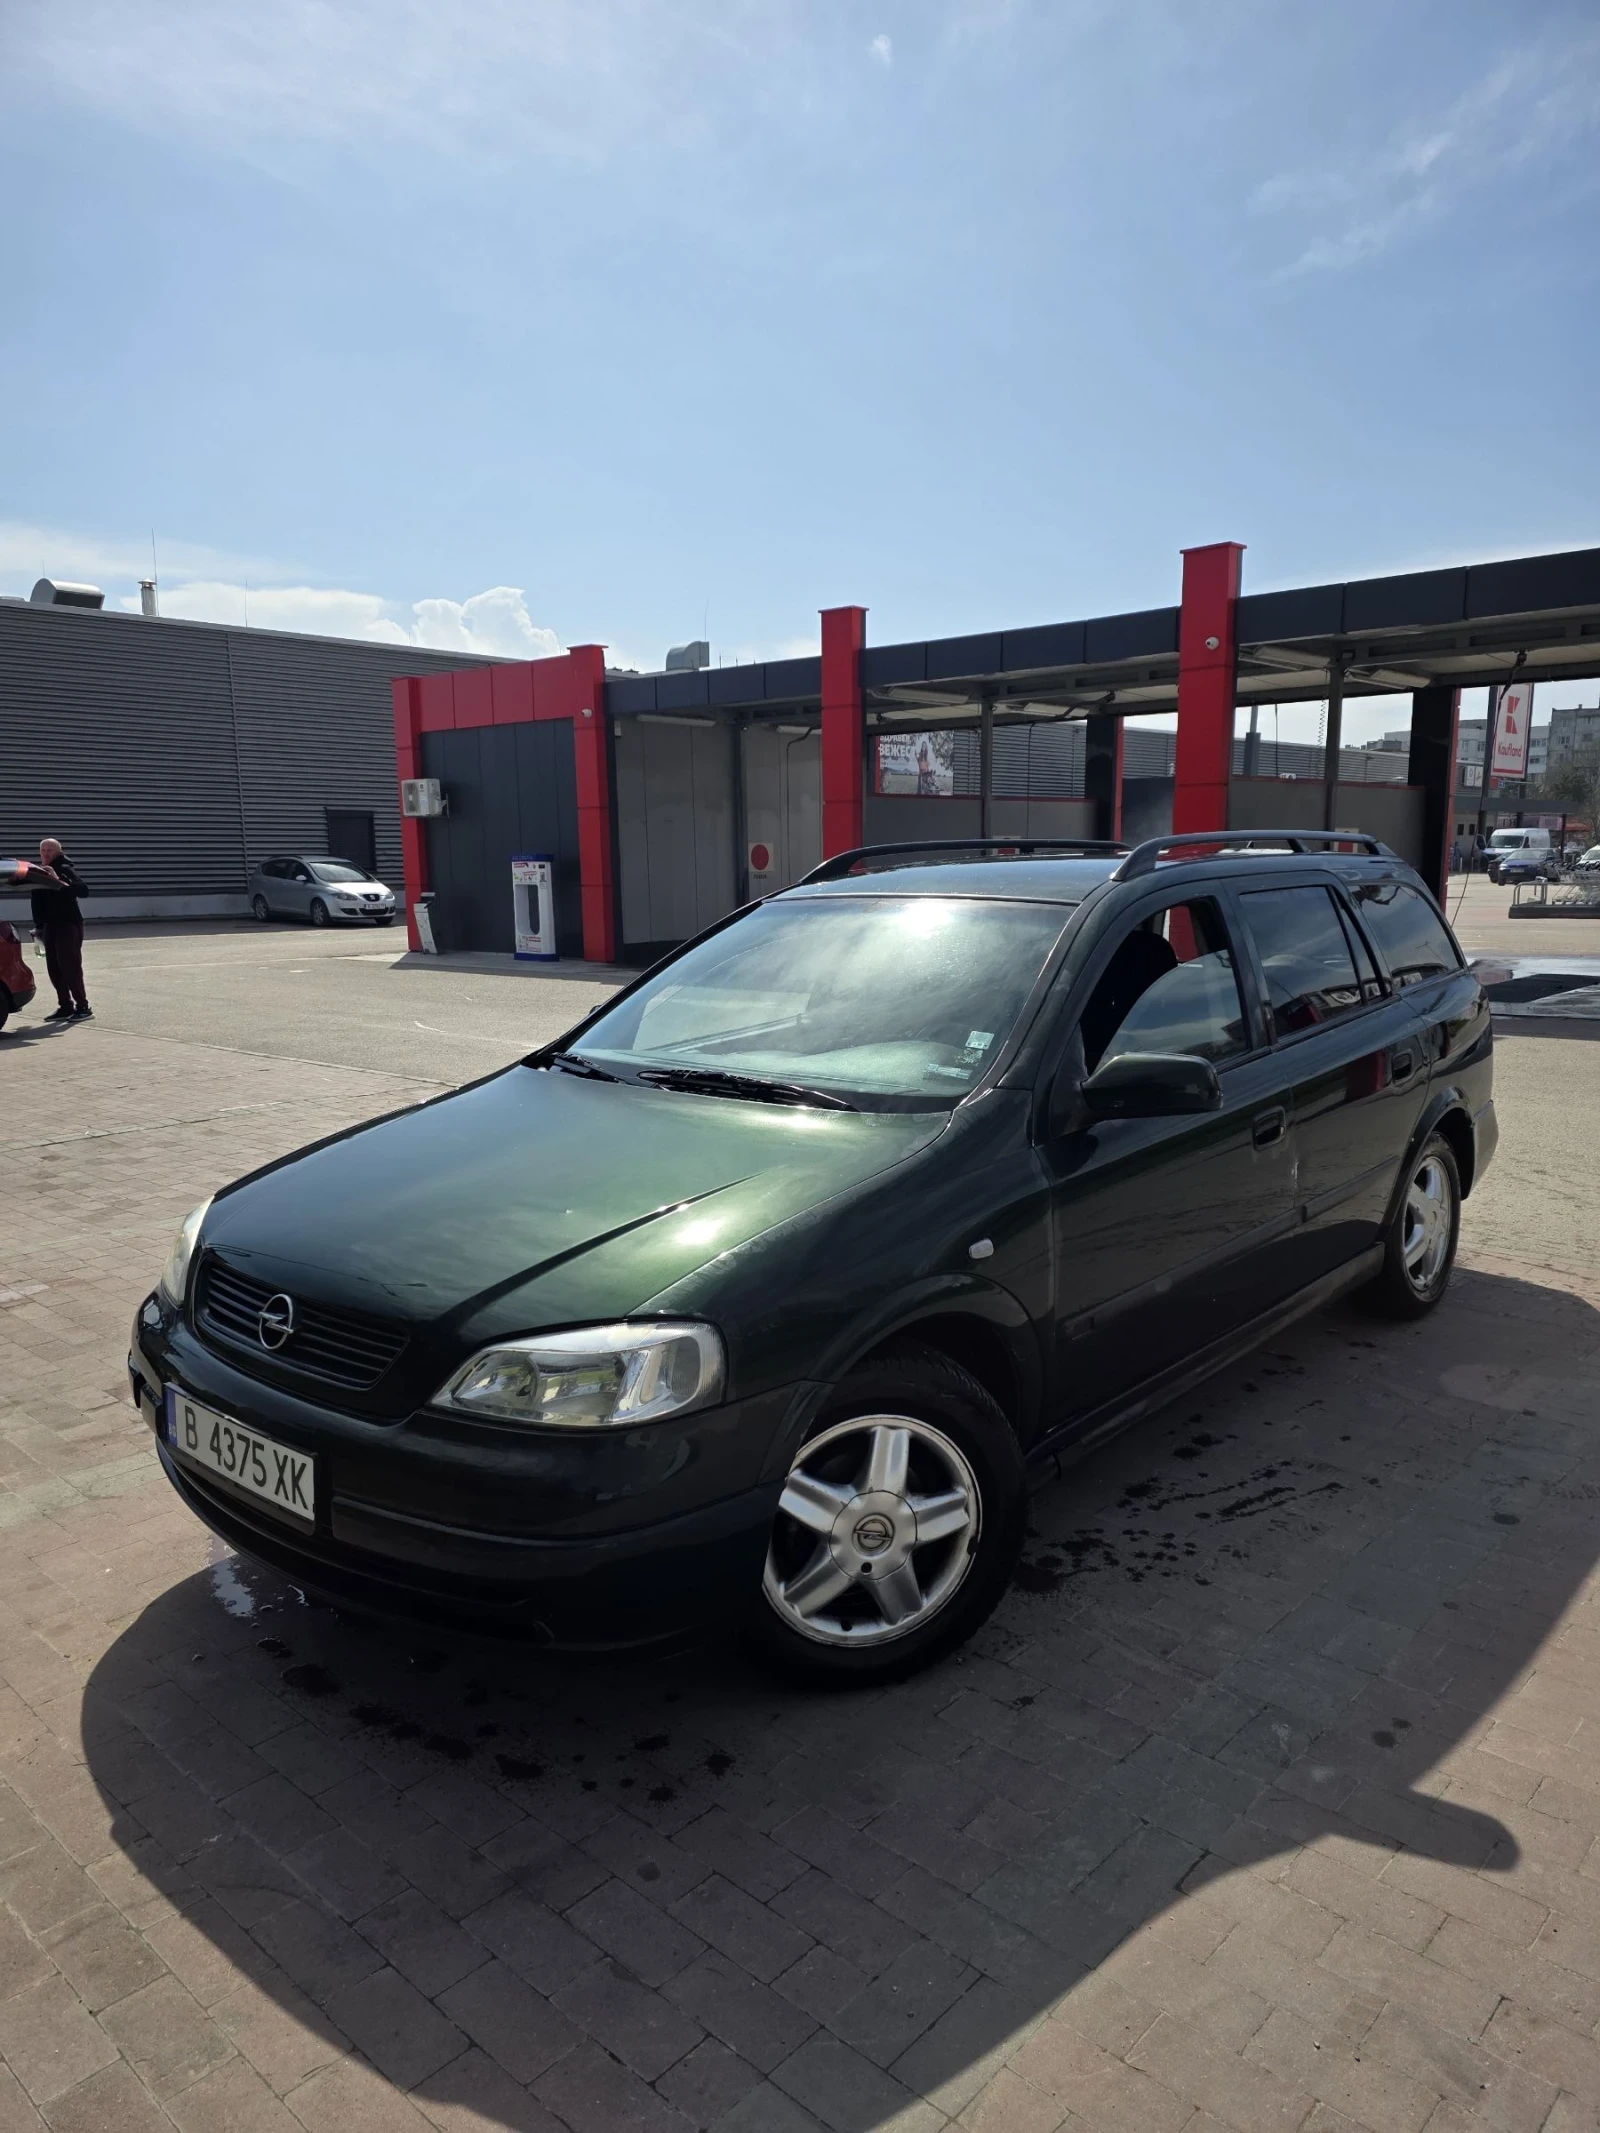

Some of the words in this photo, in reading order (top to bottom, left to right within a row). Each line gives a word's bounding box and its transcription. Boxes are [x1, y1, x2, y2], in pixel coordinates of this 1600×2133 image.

[1498, 742, 1523, 757] Kaufland
[184, 1405, 198, 1450] B
[209, 1422, 267, 1488] 4375
[273, 1449, 308, 1510] XK
